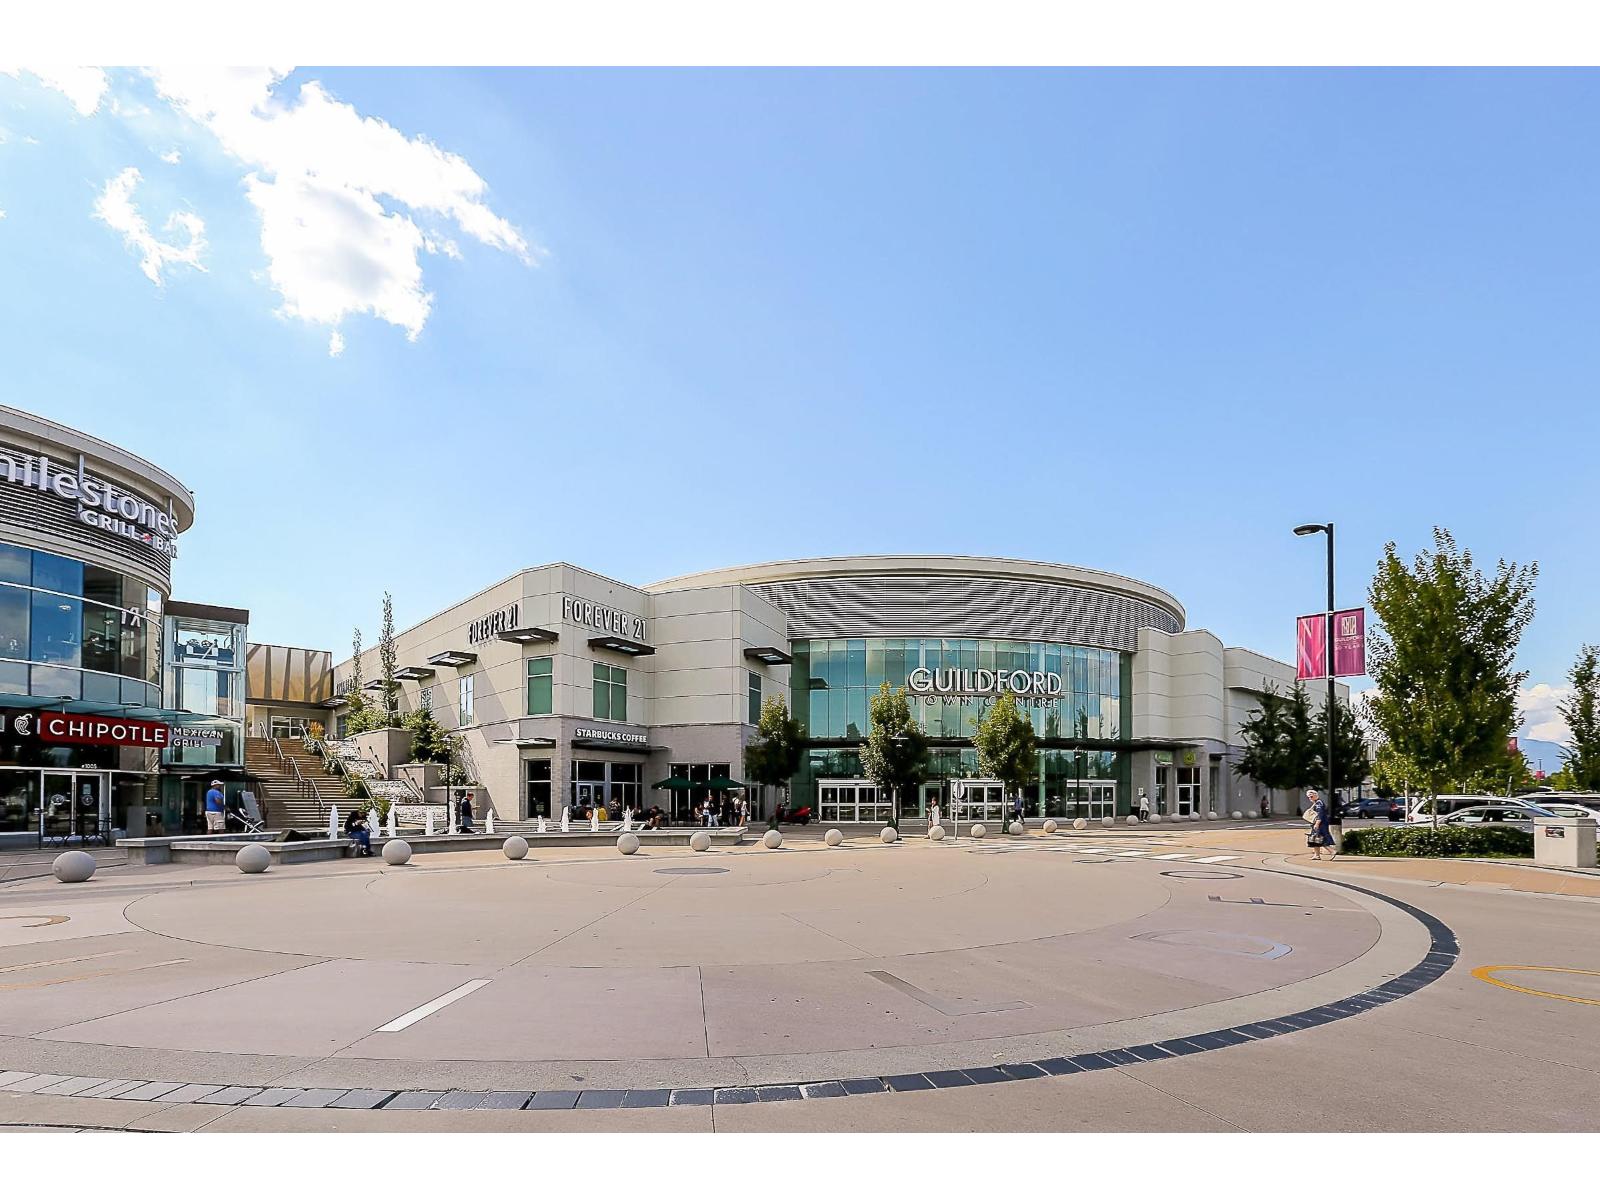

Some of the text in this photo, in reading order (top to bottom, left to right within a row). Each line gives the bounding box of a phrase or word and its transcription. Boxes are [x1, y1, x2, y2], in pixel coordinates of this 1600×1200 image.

[80, 509, 177, 559] GRILL BAR
[468, 603, 518, 645] FOREVER 21
[562, 596, 647, 641] FOREVER 21
[909, 667, 1062, 695] GUILDFORD
[914, 694, 1058, 708] TOWN CNTRE
[49, 718, 165, 743] CHIPOTLE
[173, 727, 224, 739] MEXICAN
[173, 738, 205, 748] GRILL
[576, 728, 647, 743] STARBUCKS COFFEE
